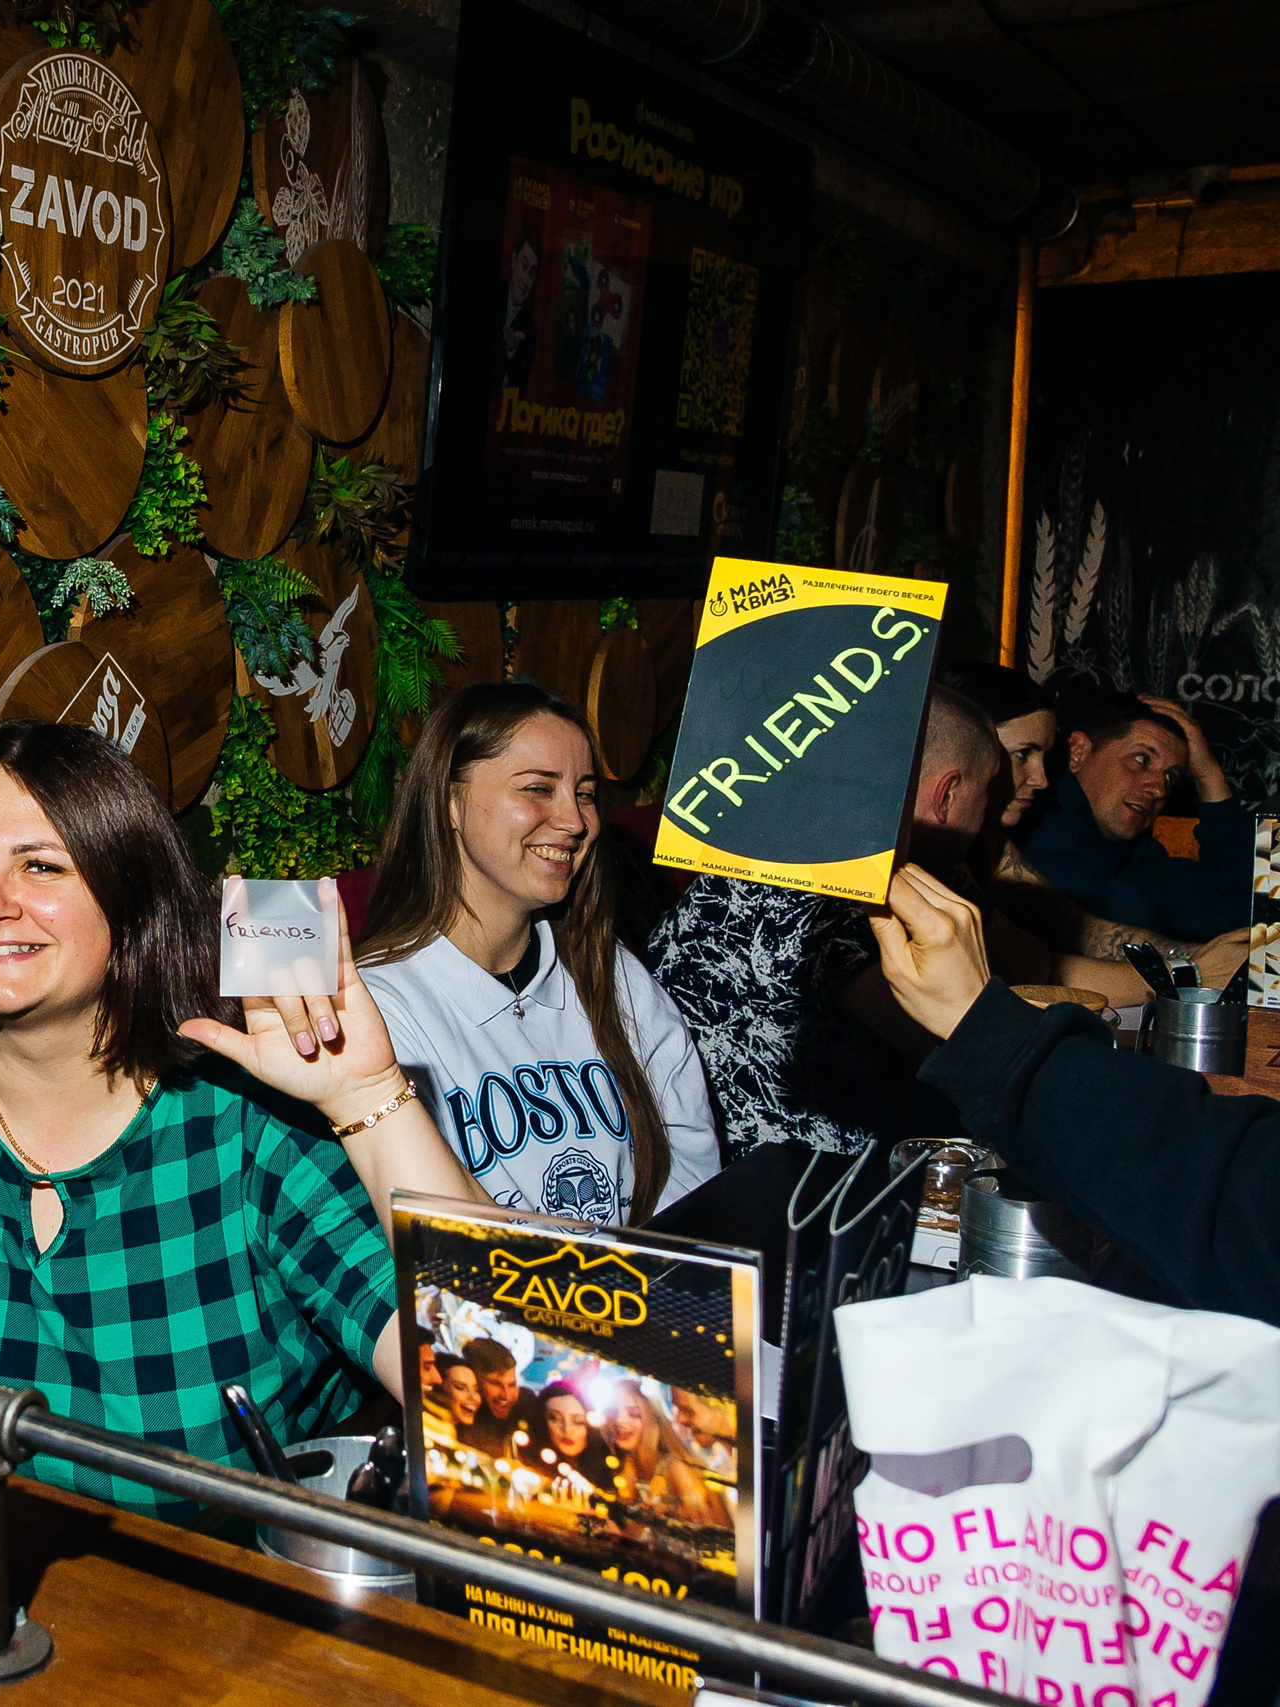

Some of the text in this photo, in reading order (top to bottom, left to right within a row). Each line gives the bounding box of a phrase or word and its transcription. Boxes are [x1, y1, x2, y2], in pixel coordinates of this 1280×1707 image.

[40, 60, 131, 117] HANDCRAFTED
[61, 100, 80, 118] AND
[10, 89, 148, 163] Always Cold
[10, 164, 148, 252] ZAVOD
[52, 274, 105, 315] 2021
[35, 313, 120, 357] GASTROPUB
[729, 573, 792, 600] МАМА
[802, 579, 935, 602] РАЗВЛЕЧЕНИЕ ТВОЕГО ВЕЧЕРА
[733, 588, 796, 614] КВИЗ!
[124, 715, 141, 746] 1864
[701, 861, 754, 878] МАМАКВИЗ!
[760, 872, 815, 889] МАМАКВИЗ!
[821, 882, 876, 900] МАМАКВИЗ!
[444, 1058, 634, 1178] BOSTO
[555, 1157, 591, 1173] SPORTS CLUB
[586, 1205, 607, 1216] SEASON
[492, 1267, 648, 1326] ZAVOD
[862, 1569, 942, 1595] ROUP
[465, 1583, 574, 1629] НА МЕНЮ КУХНИ
